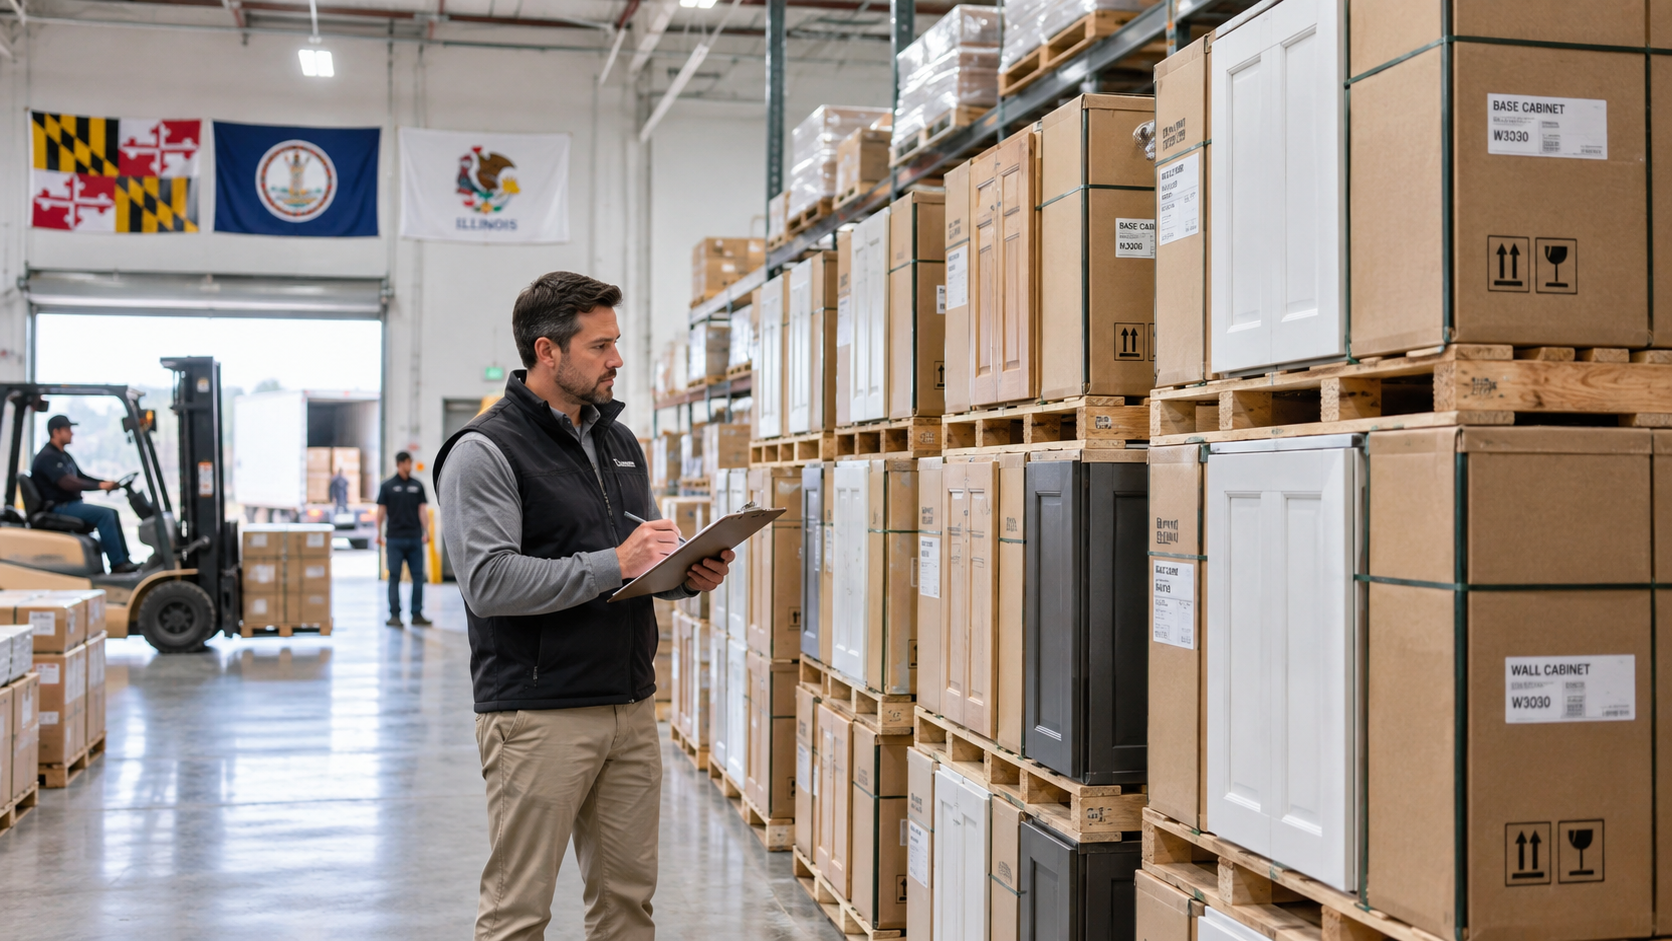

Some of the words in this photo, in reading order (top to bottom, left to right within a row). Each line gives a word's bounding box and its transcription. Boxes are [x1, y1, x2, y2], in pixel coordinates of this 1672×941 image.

[1493, 100, 1519, 112] BASE
[1522, 102, 1565, 114] CABINET
[1494, 130, 1529, 142] W3030
[456, 217, 518, 231] ILLINOIS
[1119, 222, 1138, 230] BASE
[1511, 664, 1541, 676] WALL
[1544, 663, 1590, 676] CABINET
[1512, 696, 1551, 709] W3030
